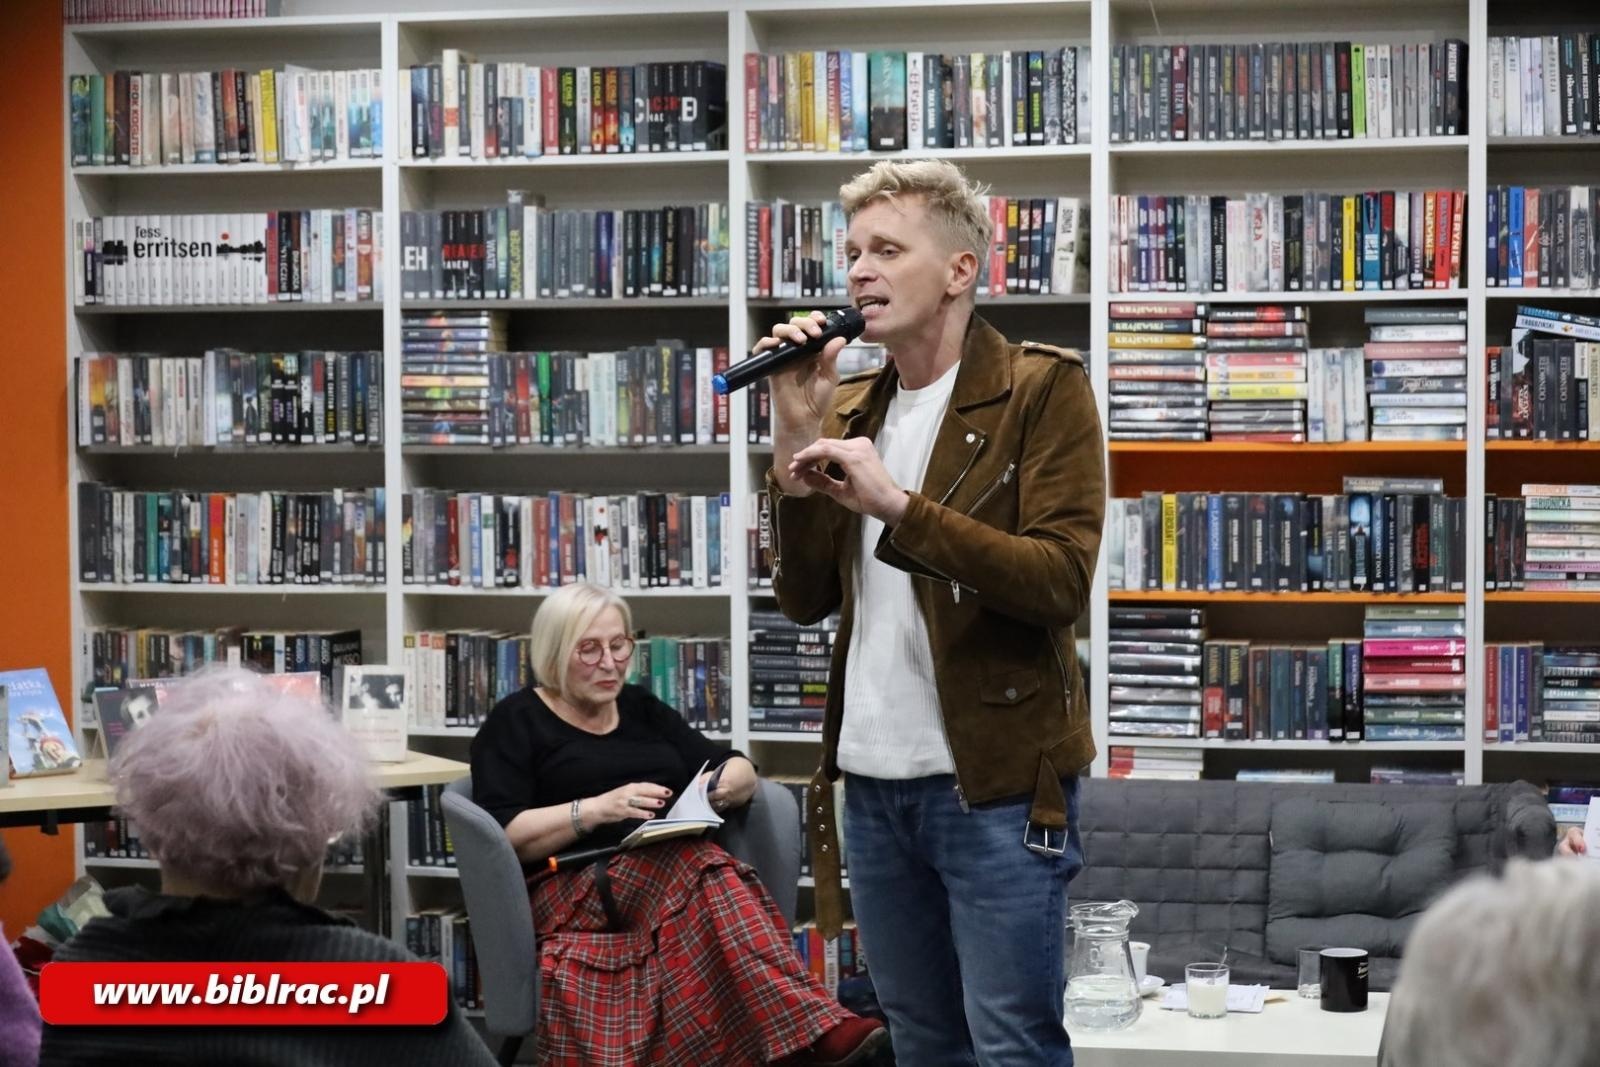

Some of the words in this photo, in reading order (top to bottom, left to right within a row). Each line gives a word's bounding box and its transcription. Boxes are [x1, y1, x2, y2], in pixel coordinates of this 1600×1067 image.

[1447, 43, 1457, 82] APARTAMENT
[1174, 82, 1185, 115] BLIZNY
[1566, 98, 1574, 122] Nesser
[1425, 198, 1435, 249] KRAJEWSKI
[1451, 213, 1461, 264] ERYNIE
[1114, 322, 1165, 332] KRAJEWSKI
[1118, 305, 1169, 315] KRAJEWSKI
[1114, 334, 1165, 345] KRAJEWSKI
[1537, 356, 1547, 402] REDONDO
[1558, 356, 1568, 402] REDONDO
[759, 509, 770, 549] CEDER
[1211, 510, 1220, 551] LARSSON
[1338, 530, 1346, 551] LINK
[799, 633, 820, 643] WINA
[1230, 648, 1240, 686] MARININA
